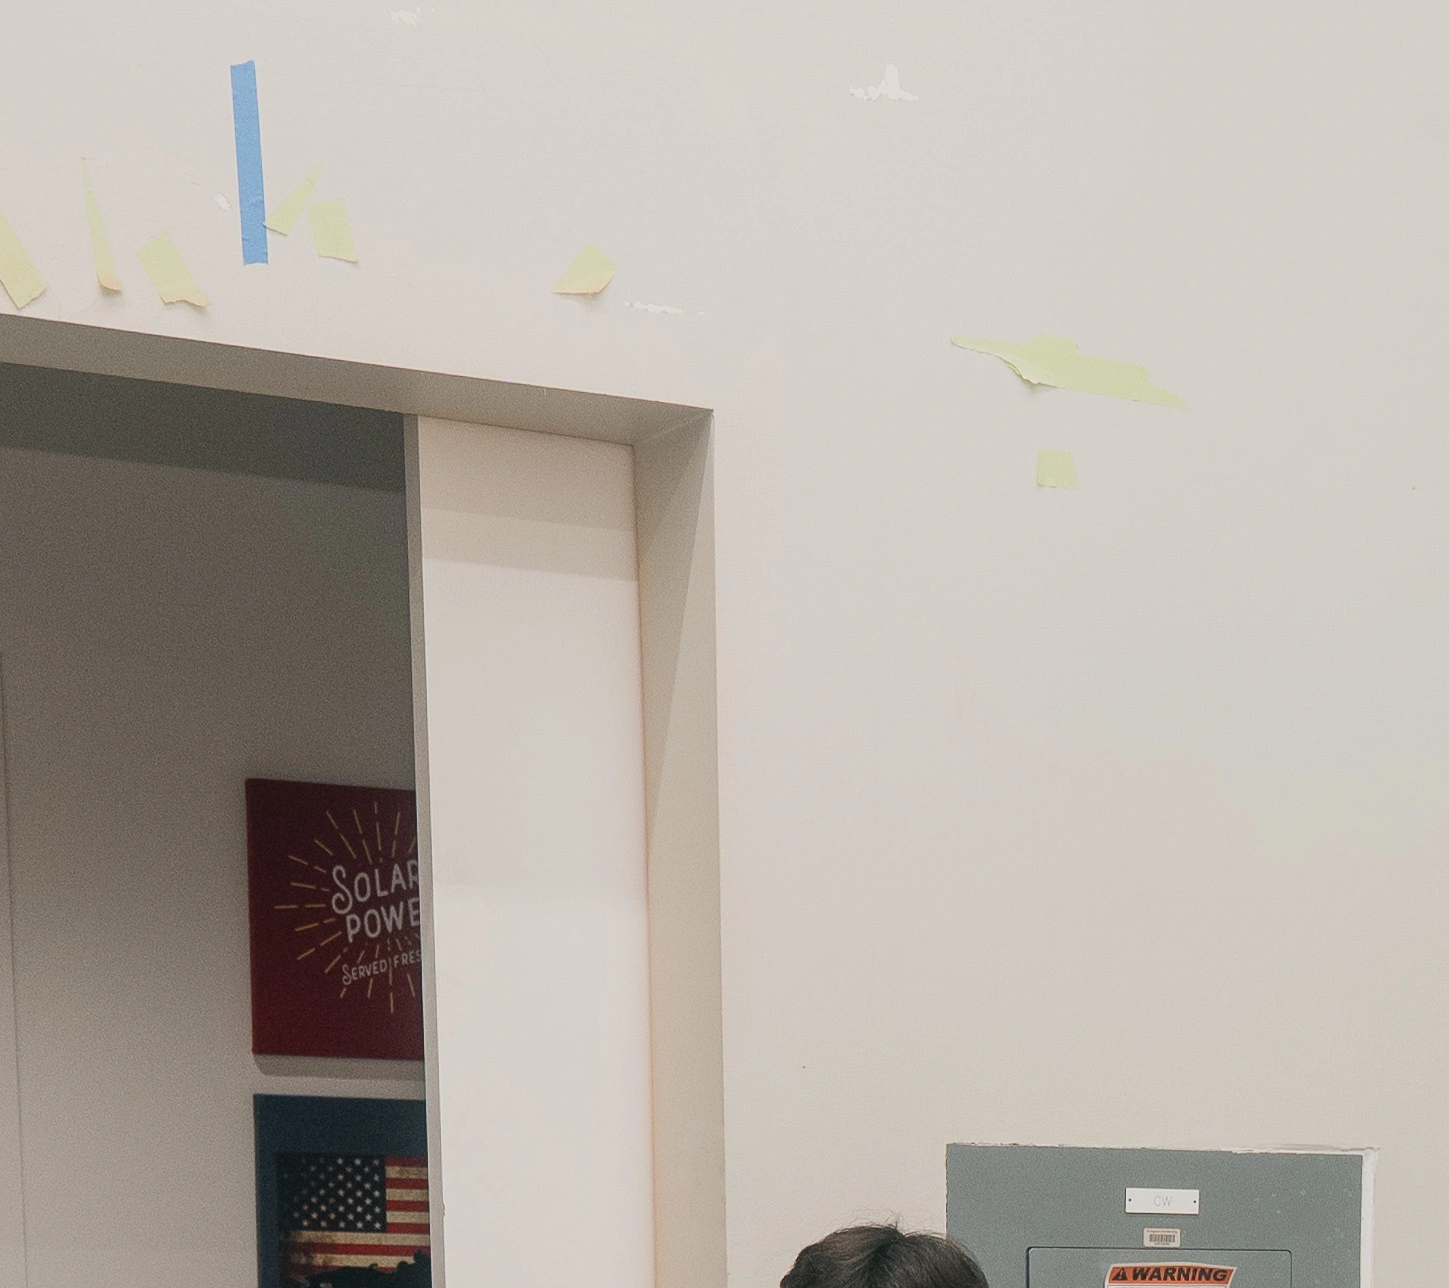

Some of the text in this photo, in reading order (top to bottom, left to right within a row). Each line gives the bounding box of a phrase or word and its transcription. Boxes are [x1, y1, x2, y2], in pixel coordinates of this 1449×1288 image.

[332, 860, 419, 914] SOLAR
[342, 960, 388, 985] SERVED
[1153, 1195, 1172, 1206] CW
[1132, 1266, 1228, 1281] WARNING
